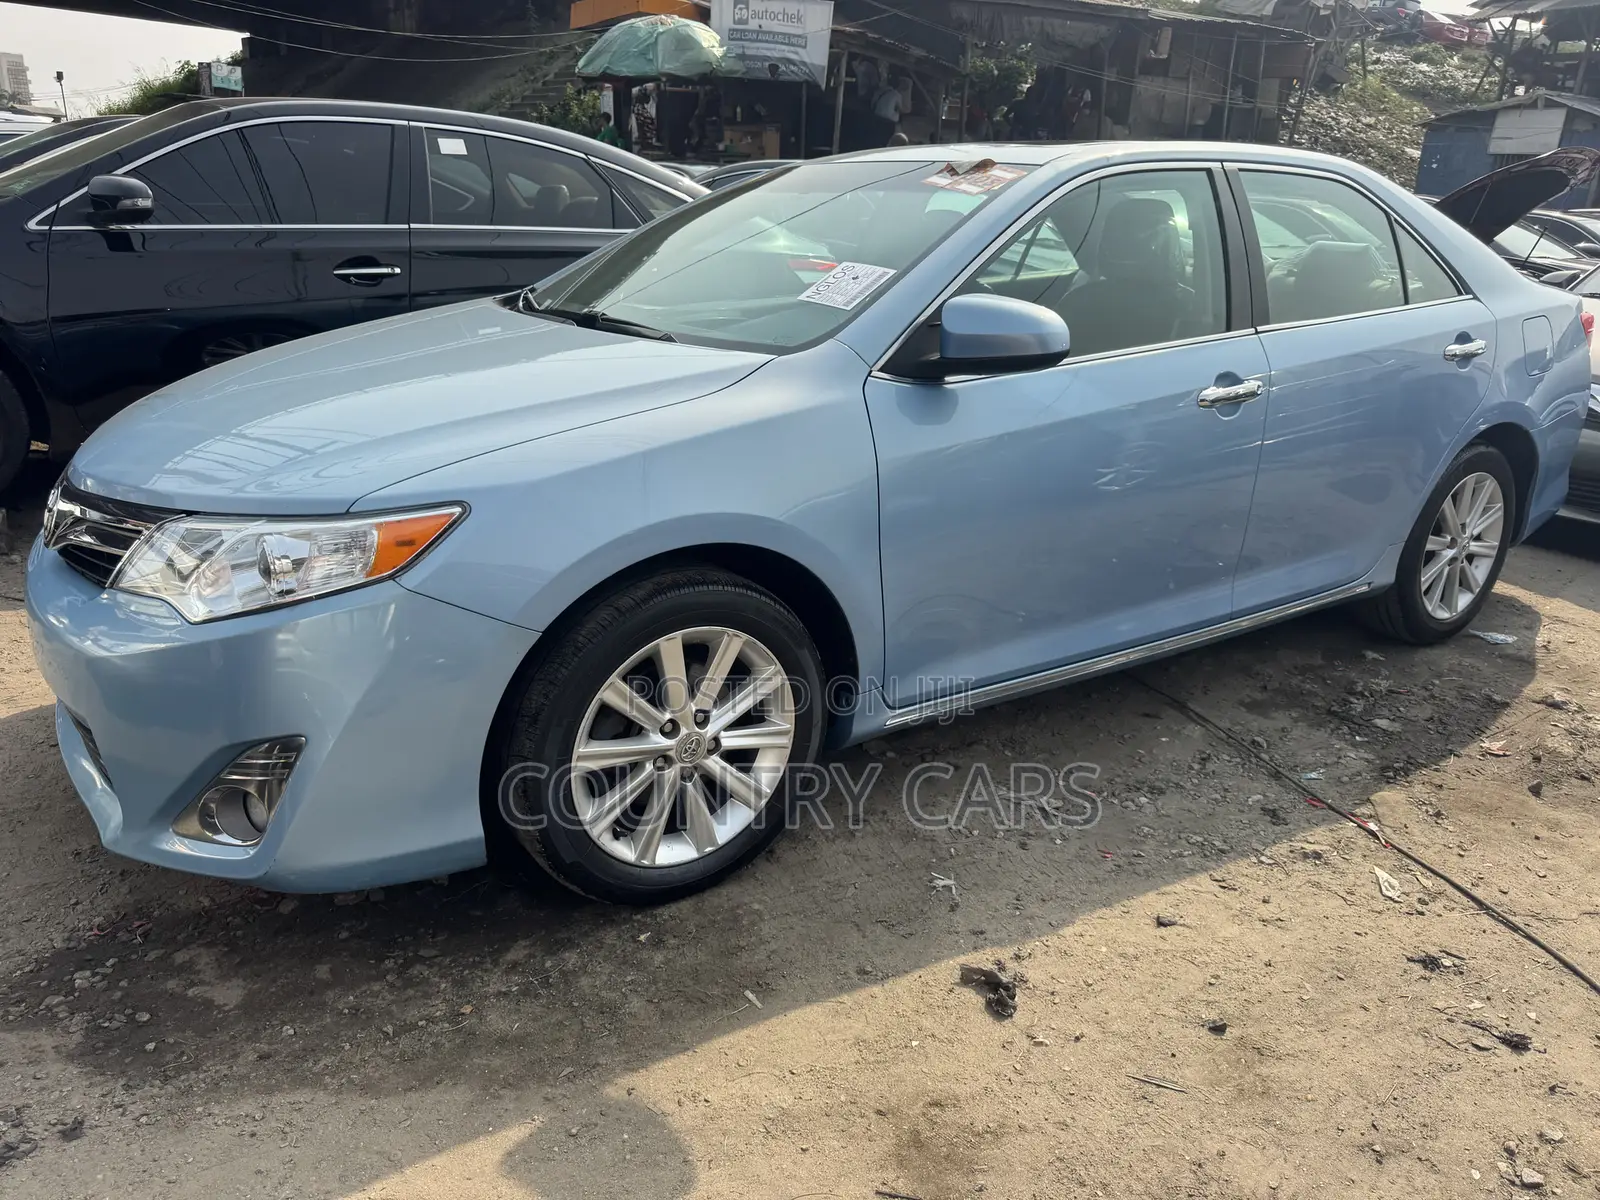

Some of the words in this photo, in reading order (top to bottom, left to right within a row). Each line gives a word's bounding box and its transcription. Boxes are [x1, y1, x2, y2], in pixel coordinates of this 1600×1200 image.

[751, 7, 804, 24] autochek
[729, 31, 741, 39] CAR
[742, 32, 757, 40] LOAN
[758, 33, 789, 43] AVAILABLE
[789, 36, 806, 46] HERE
[806, 265, 855, 299] NGLOS
